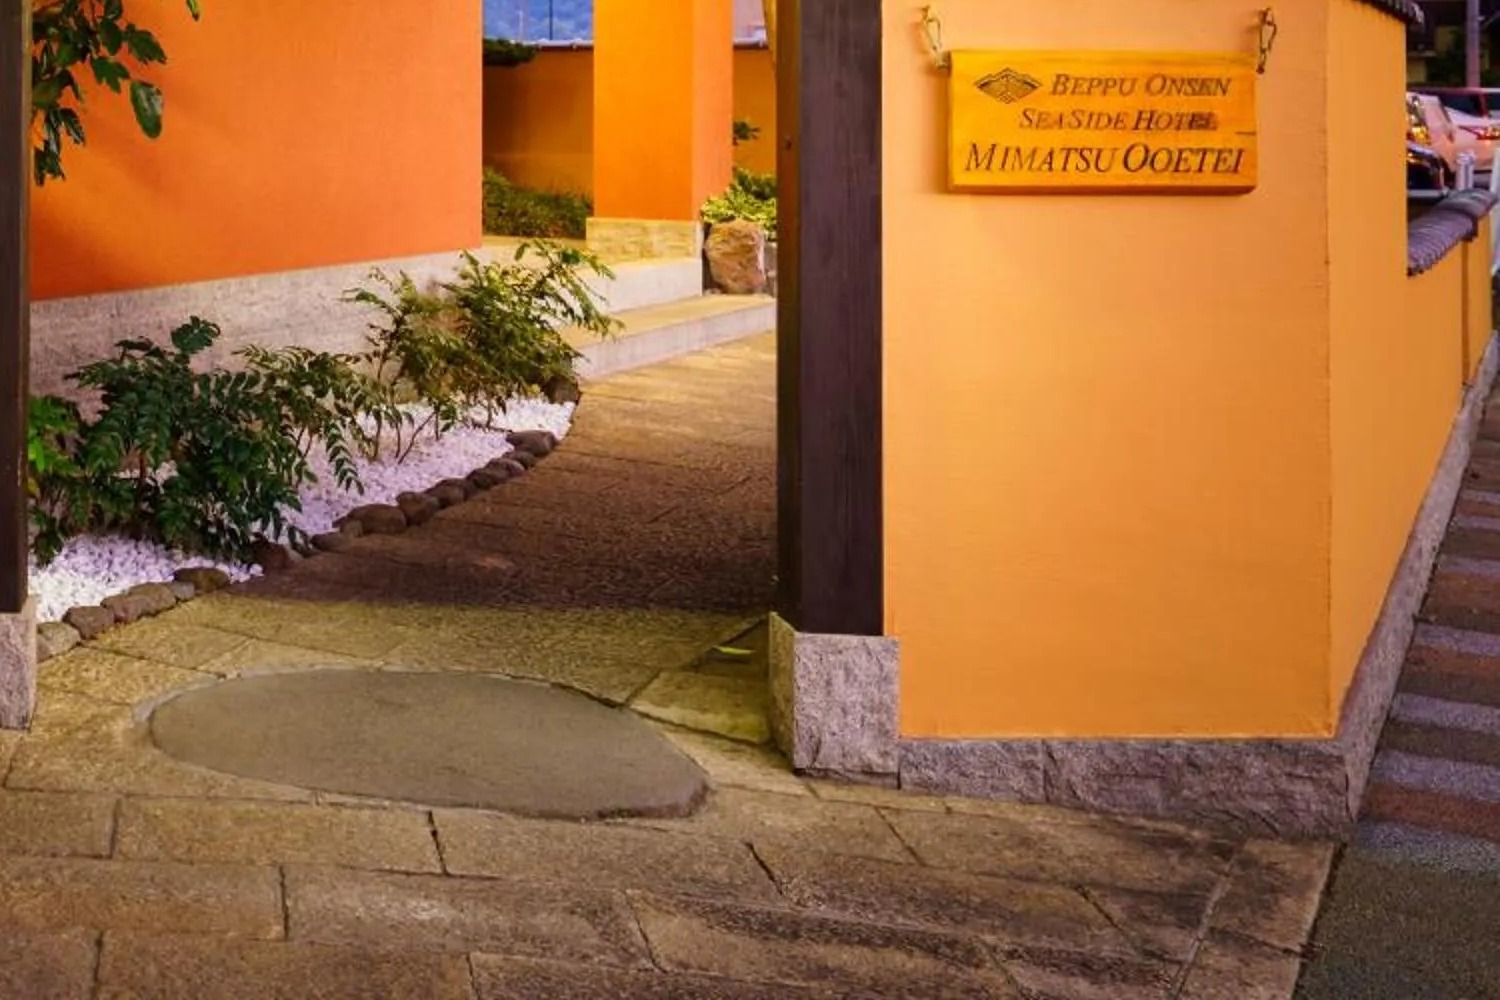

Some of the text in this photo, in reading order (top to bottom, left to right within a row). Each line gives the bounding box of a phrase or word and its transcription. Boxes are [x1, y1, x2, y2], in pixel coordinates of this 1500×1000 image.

[1050, 73, 1232, 97] BEPPU ONSEN
[1131, 108, 1219, 131] HOTEL
[964, 141, 1245, 175] MIMATSU OOETEI
